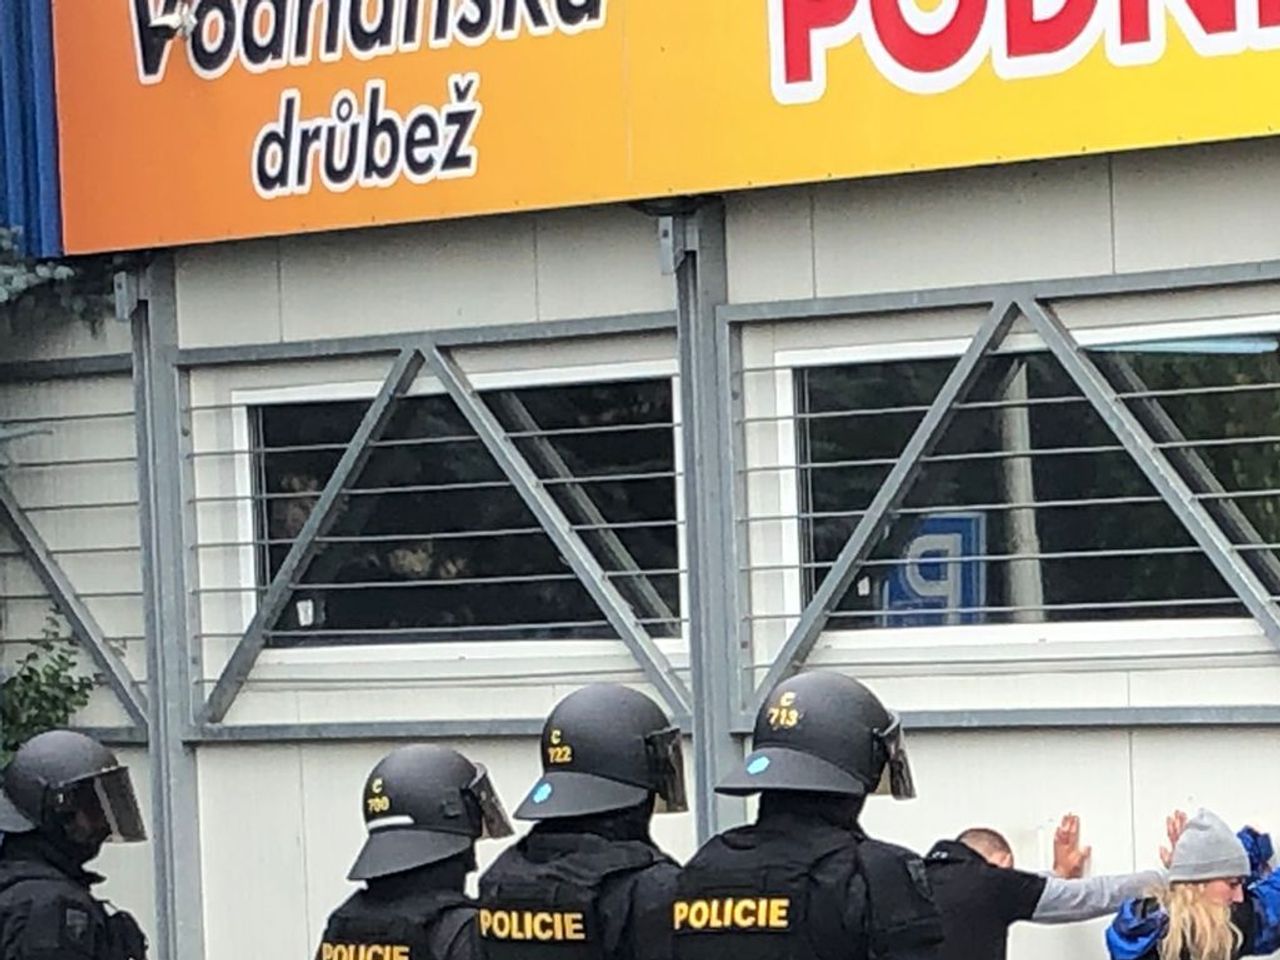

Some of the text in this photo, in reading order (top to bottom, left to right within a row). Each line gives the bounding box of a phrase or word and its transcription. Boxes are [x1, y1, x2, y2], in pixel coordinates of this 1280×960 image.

[256, 79, 478, 191] drůbež
[551, 729, 561, 745] C
[372, 778, 383, 794] C
[479, 909, 586, 941] POLICIE
[673, 898, 790, 930] POLICIE
